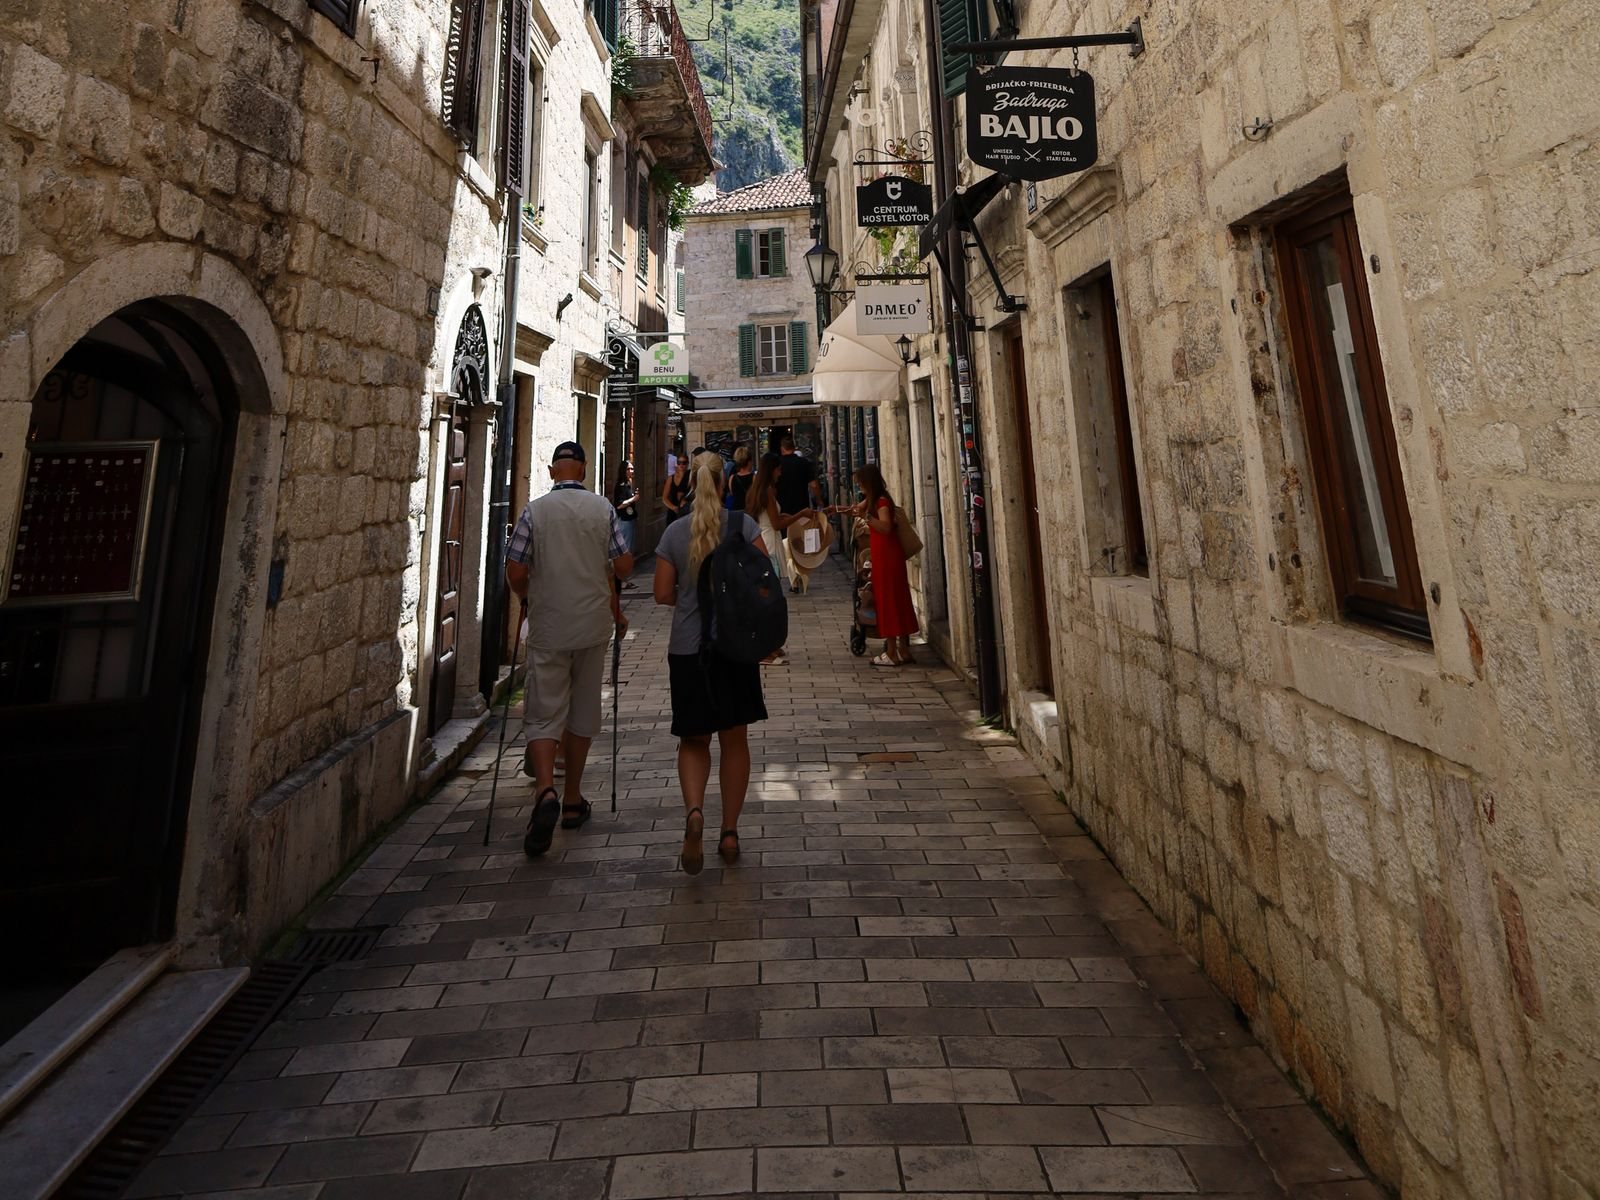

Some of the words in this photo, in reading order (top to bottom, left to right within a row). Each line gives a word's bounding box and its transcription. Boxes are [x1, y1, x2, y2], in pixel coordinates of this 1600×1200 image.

[992, 91, 1069, 113] Zadruga
[980, 113, 1083, 144] BAJLO
[873, 205, 918, 214] CENTRUM
[862, 214, 898, 223] HOSTEL
[899, 213, 930, 222] KOTOR
[864, 303, 916, 316] DAMEO
[653, 366, 675, 374] BENU
[644, 376, 684, 384] APOTEKA
